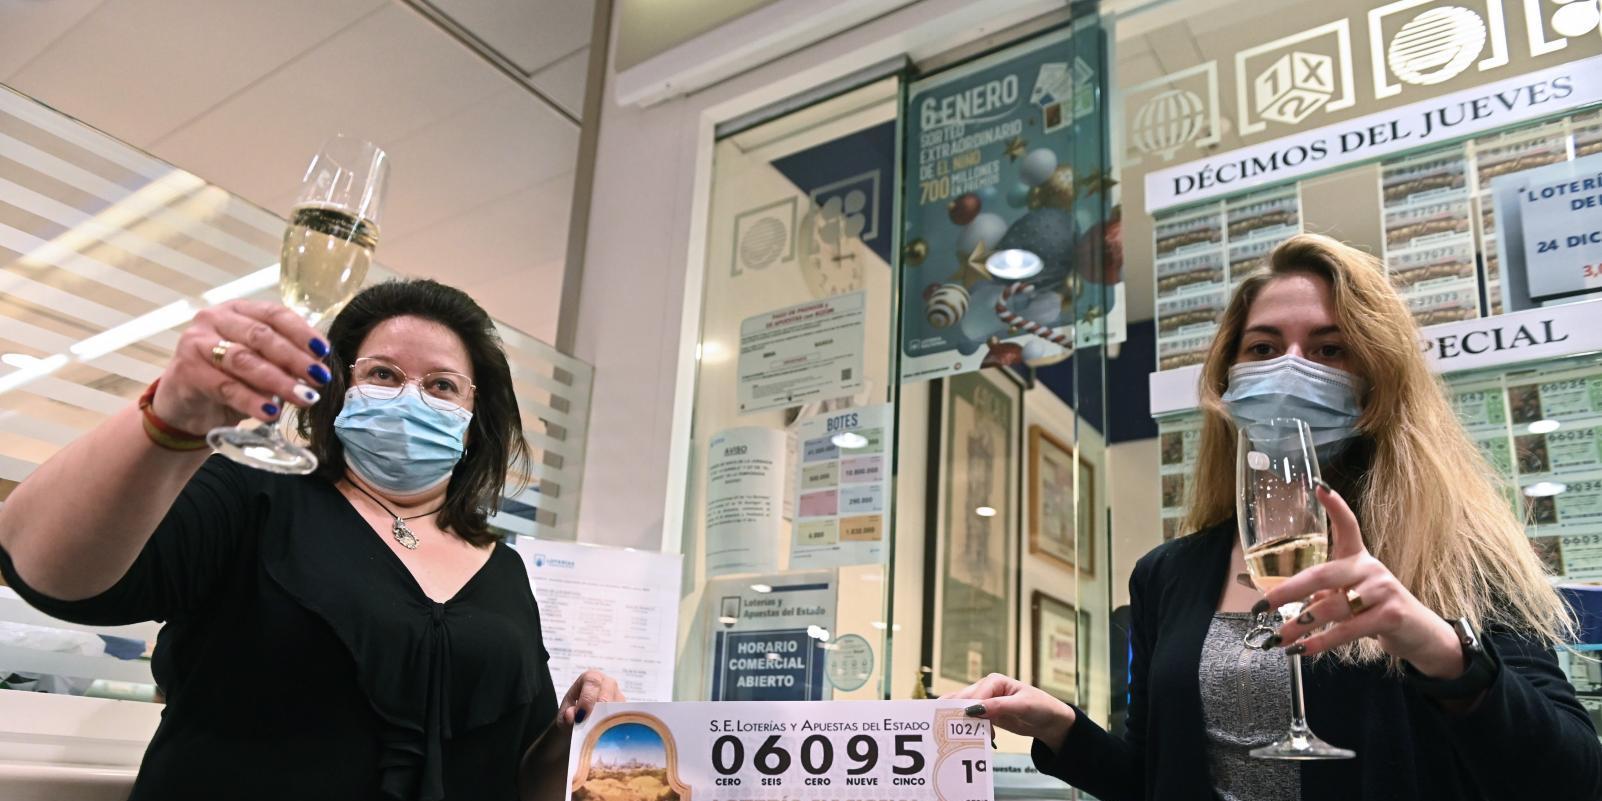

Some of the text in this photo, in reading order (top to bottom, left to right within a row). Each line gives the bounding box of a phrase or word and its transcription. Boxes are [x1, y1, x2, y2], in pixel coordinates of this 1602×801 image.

[920, 74, 1018, 132] 6 ENERO
[920, 124, 965, 148] SORTEO
[920, 119, 1022, 164] EXTRAORDINARIO
[1172, 75, 1574, 196] DÉCIMOS DEL JUEVES
[920, 163, 935, 181] DE
[937, 160, 948, 177] EL
[920, 160, 999, 206] 700 MILLONES
[1571, 194, 1602, 211] DE
[1537, 239, 1559, 253] 24
[826, 412, 858, 432] BOTES
[743, 609, 780, 620] Apuestas
[796, 605, 826, 616] Estado
[737, 641, 798, 654] HORARIO
[728, 657, 805, 670] COMERCIAL
[736, 675, 794, 688] ABIERTO
[790, 723, 797, 731] Y
[801, 720, 858, 732] APUESTAS
[862, 722, 881, 731] DEL
[884, 719, 930, 731] ESTADO
[950, 722, 984, 736] 102/
[712, 734, 925, 776] 06095
[715, 777, 925, 786] CERO SEIS CERO NUEVE CINCO
